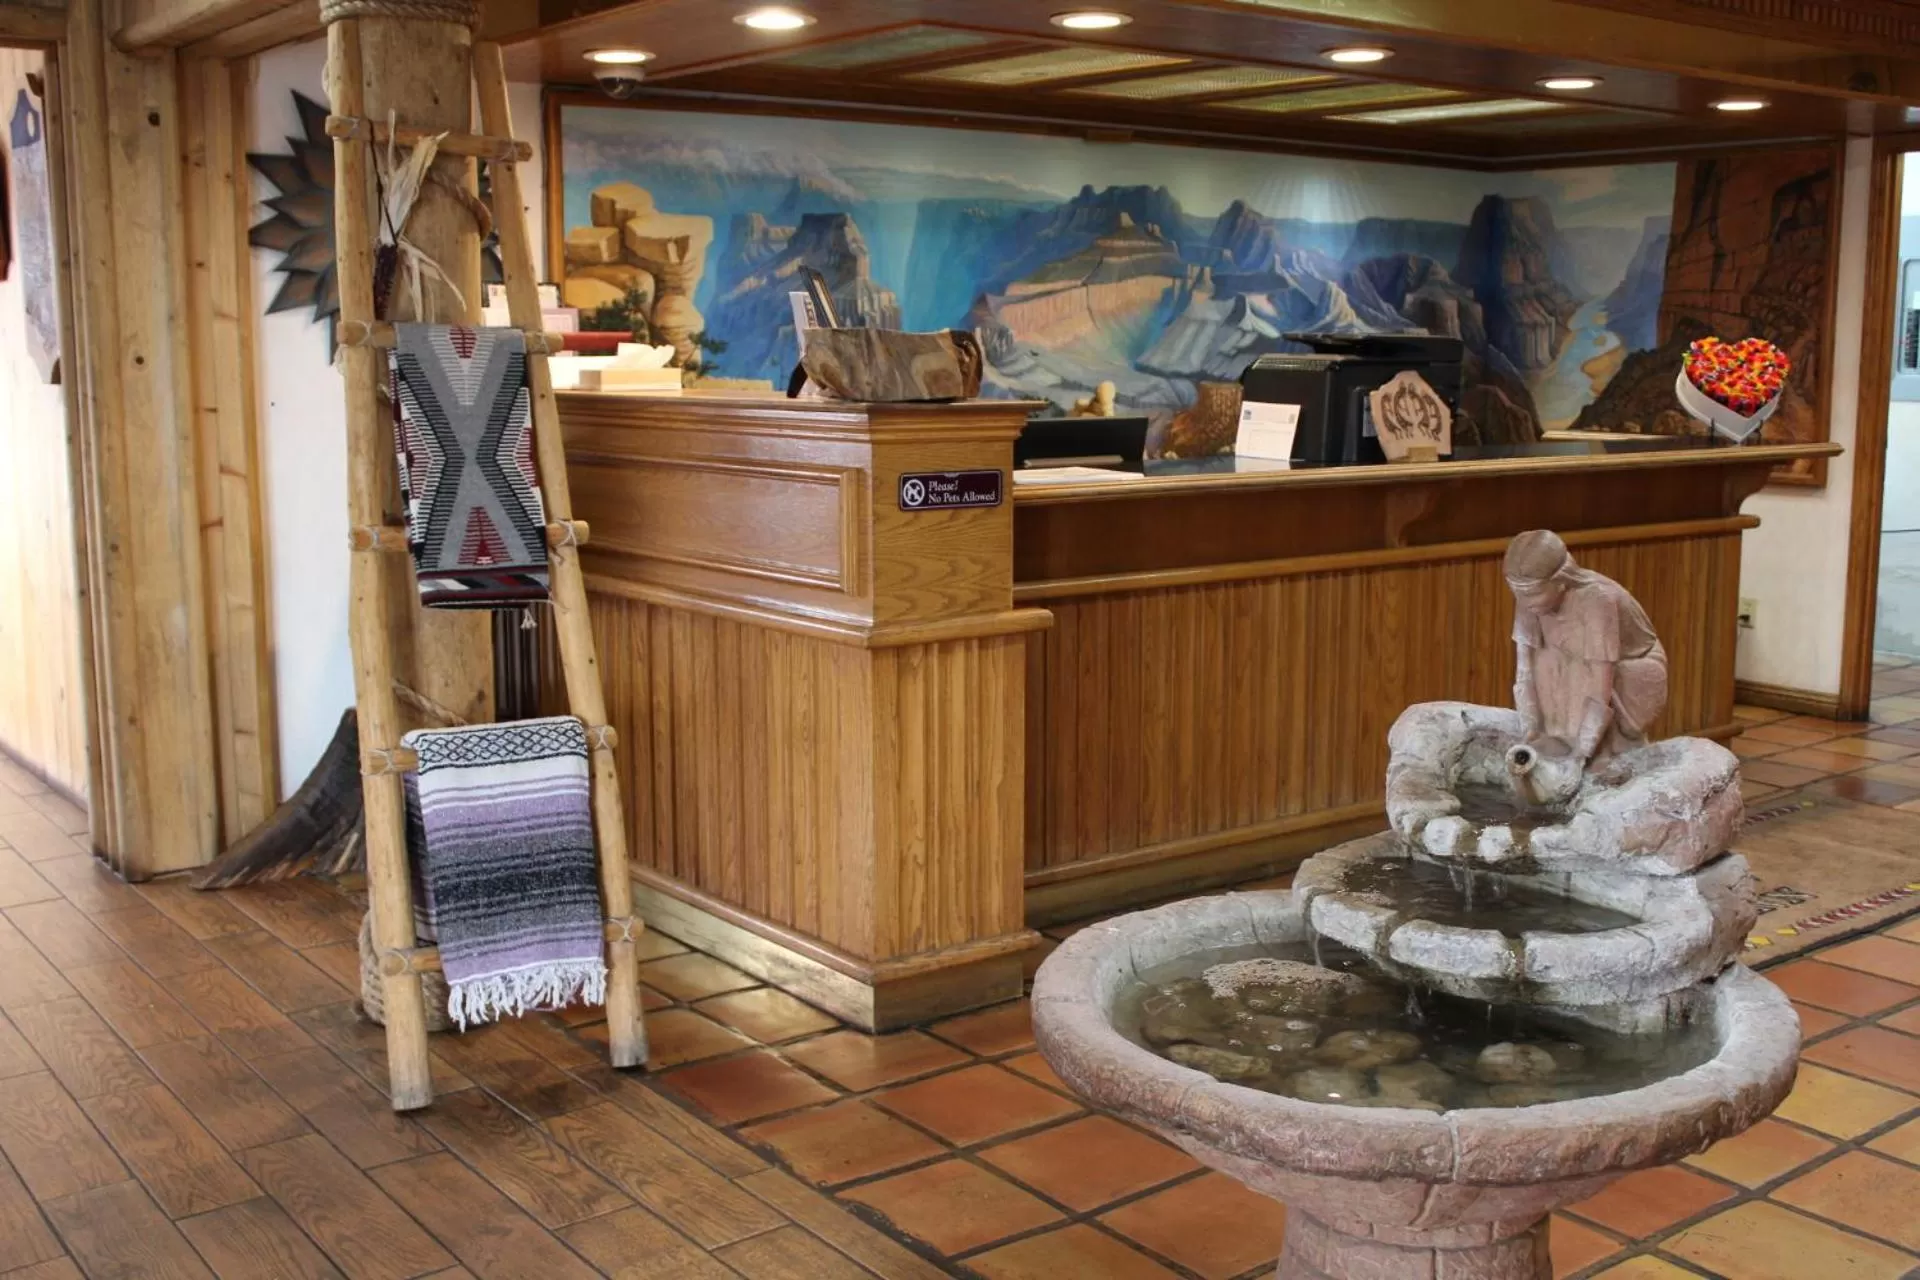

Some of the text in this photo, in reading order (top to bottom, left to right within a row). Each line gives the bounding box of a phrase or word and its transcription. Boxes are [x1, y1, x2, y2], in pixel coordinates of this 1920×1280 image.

[928, 480, 959, 491] Please!
[928, 490, 995, 504] No Pets Allowed
